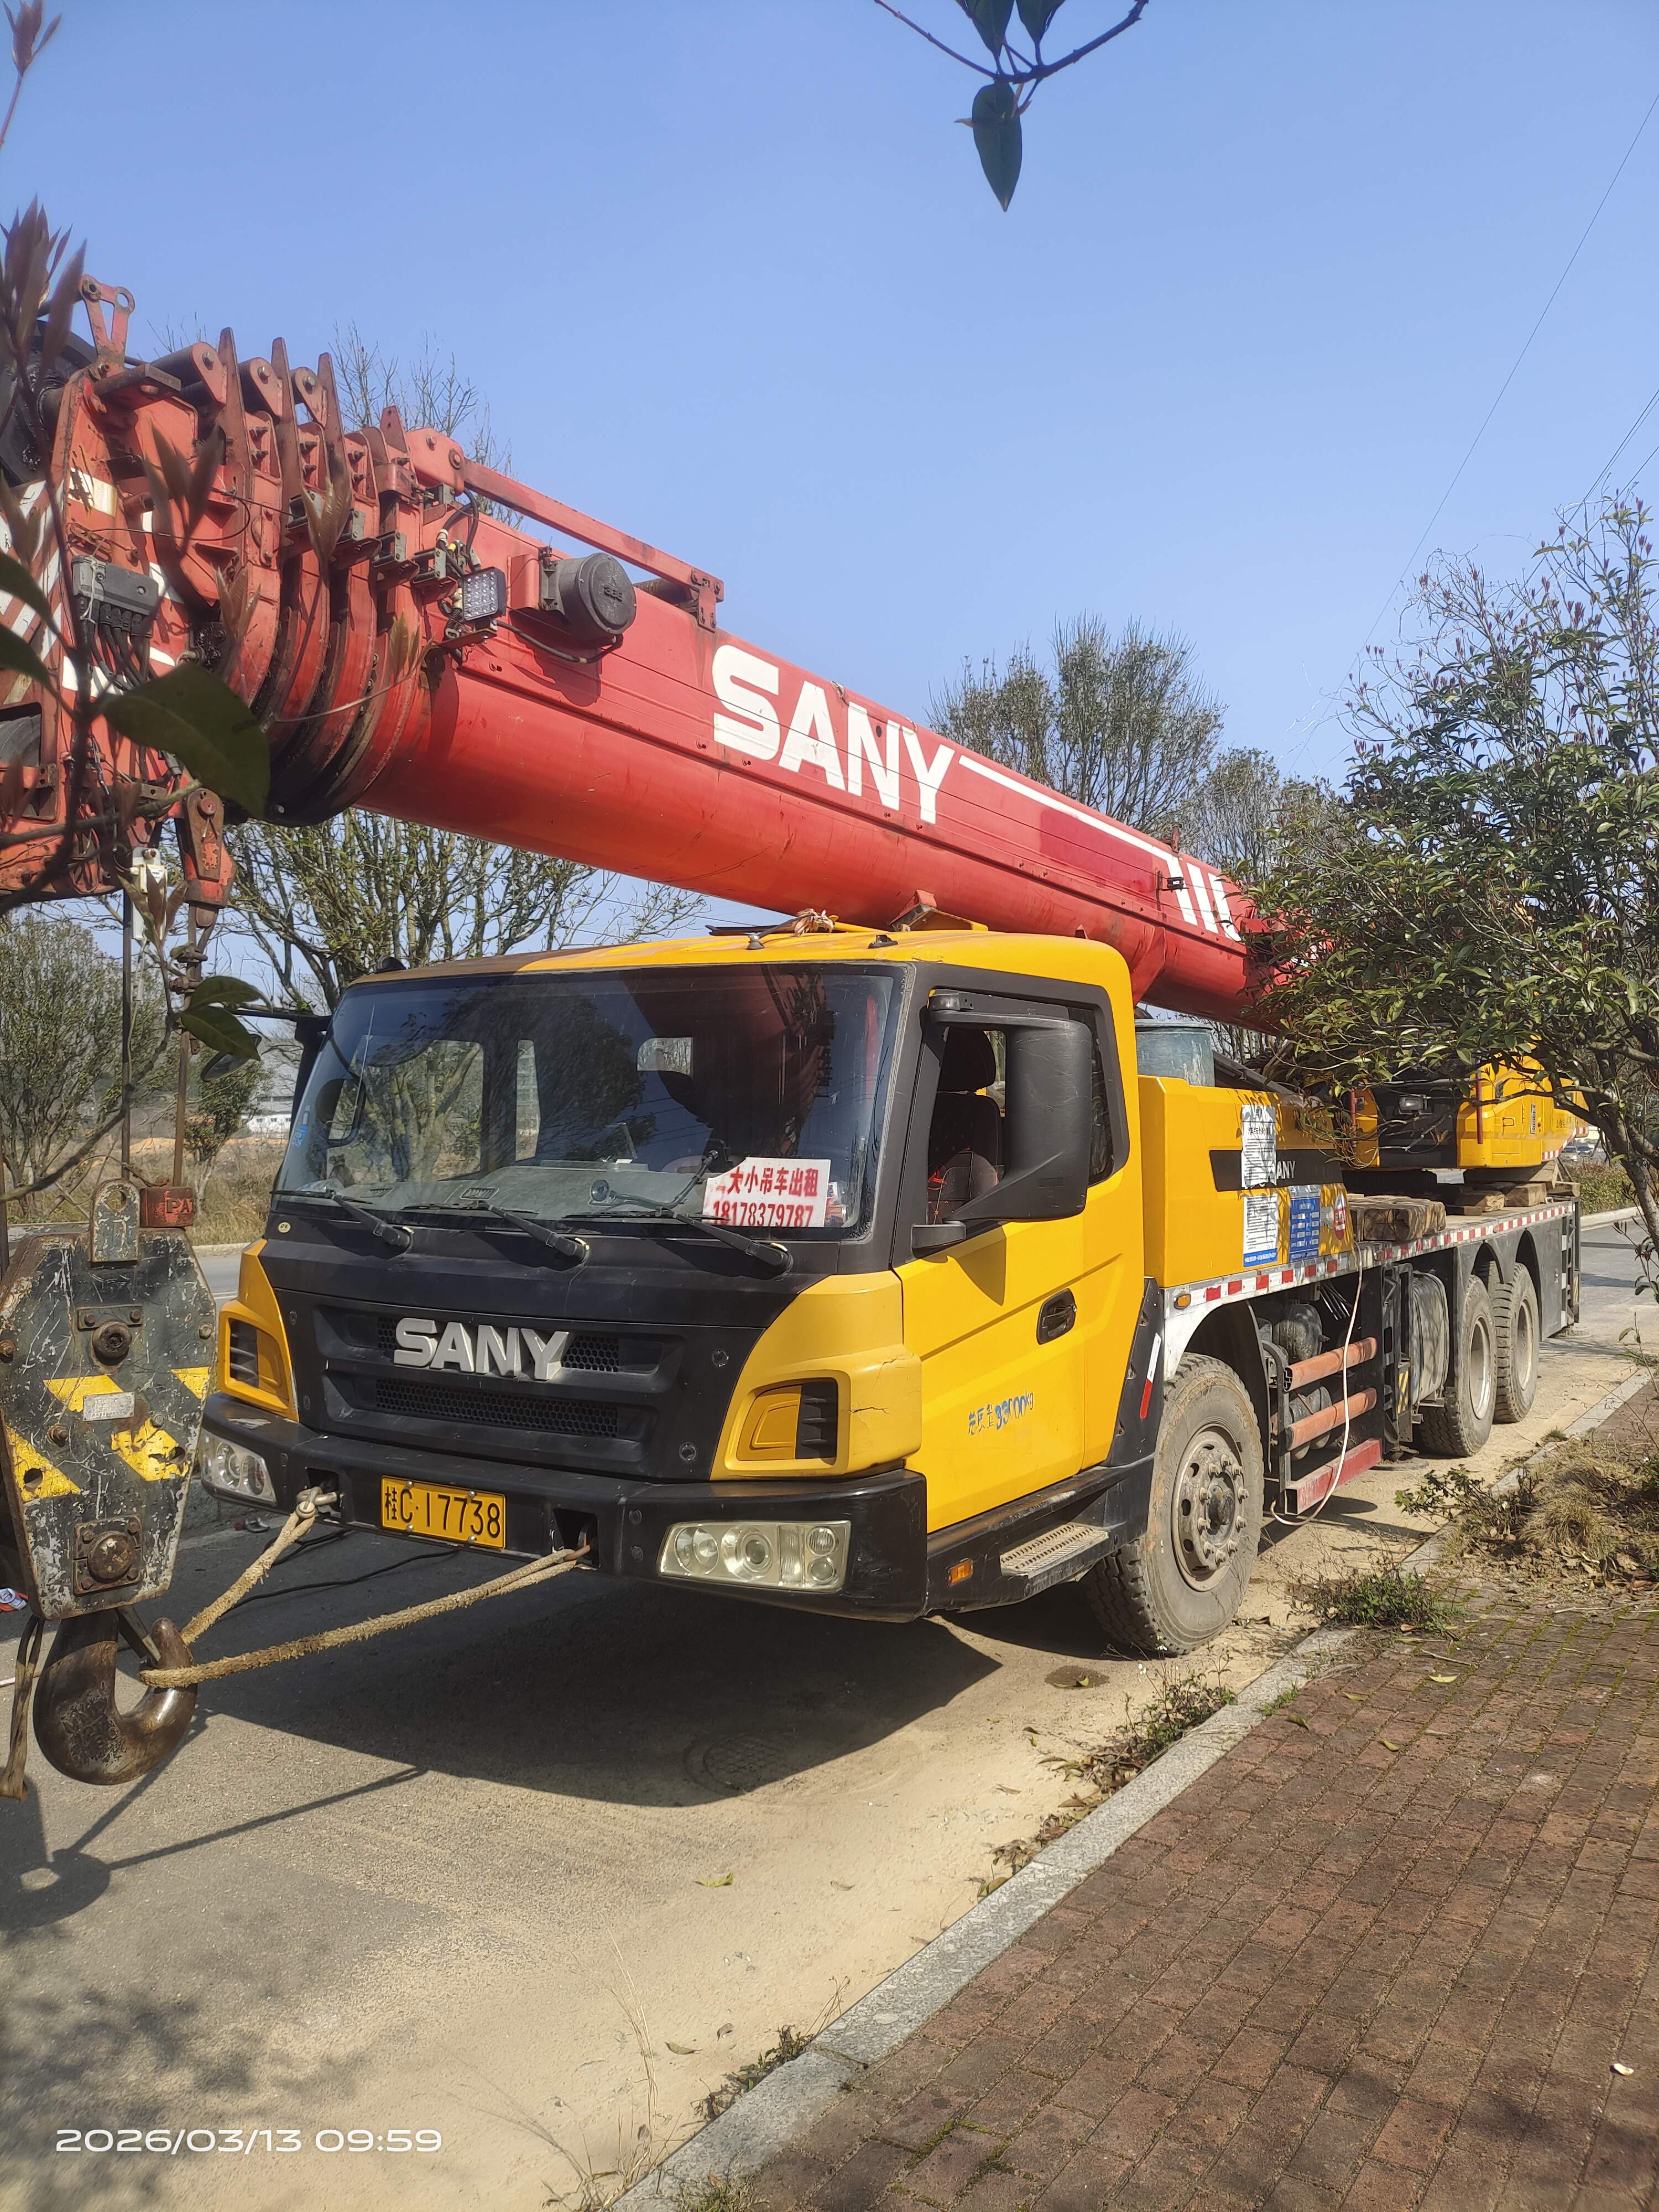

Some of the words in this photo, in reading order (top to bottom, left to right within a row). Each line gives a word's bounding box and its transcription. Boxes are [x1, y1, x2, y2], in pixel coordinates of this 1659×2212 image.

[712, 645, 954, 824] SANY
[727, 1166, 818, 1197] 大小吊车出租
[1277, 1161, 1295, 1179] ANY
[713, 1200, 813, 1227] 18178379787
[394, 1318, 569, 1380] SANY
